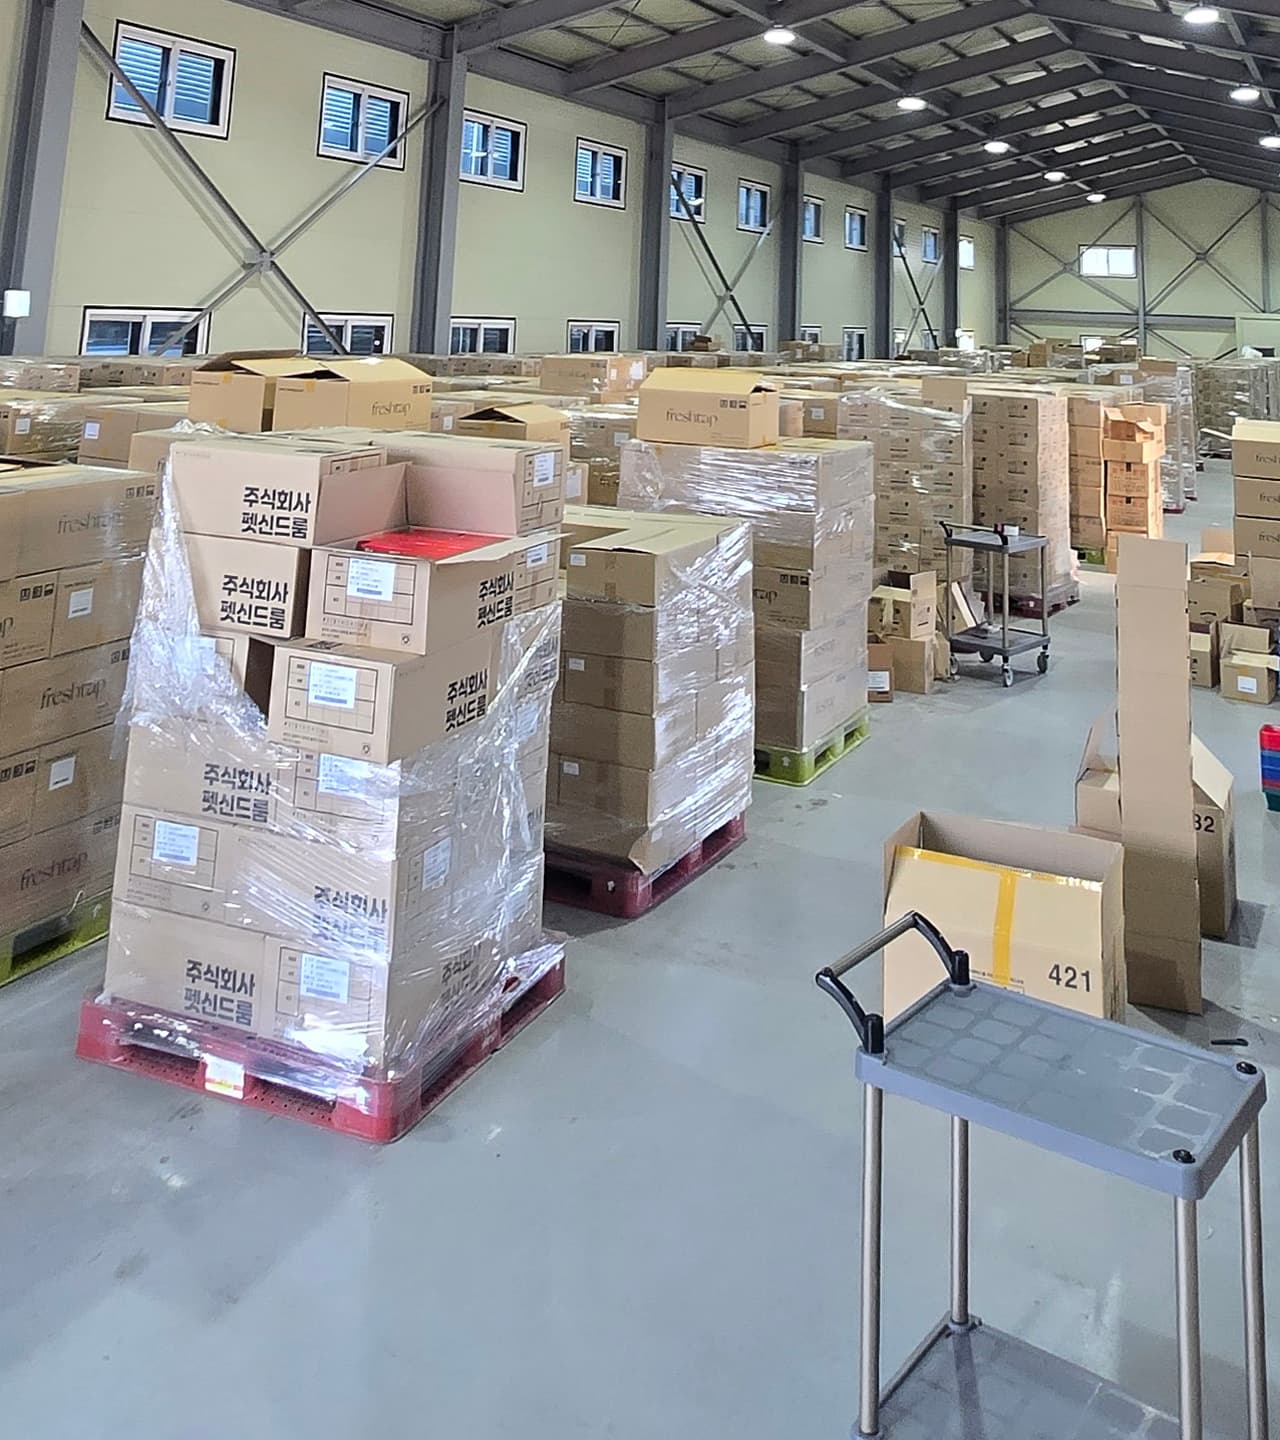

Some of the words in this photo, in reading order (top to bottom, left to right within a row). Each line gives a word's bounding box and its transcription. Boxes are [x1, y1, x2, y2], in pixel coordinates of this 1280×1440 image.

[371, 400, 411, 416] freshtap
[666, 409, 718, 427] freshtap
[243, 486, 311, 513] 주식회사
[241, 512, 308, 539] 펫신드룸
[222, 574, 289, 604] 주식회사
[479, 572, 514, 602] 주식회사
[220, 600, 286, 630] 펫신드룸
[477, 596, 513, 628] 펫신드룸
[41, 678, 107, 709] freshtap
[447, 669, 489, 704] 주식회사
[446, 694, 487, 732] 펫신드룸
[203, 763, 272, 796] 주식회사
[202, 790, 269, 823] 펫신드룸
[21, 852, 88, 891] freshtap
[186, 960, 255, 997] 주식회사
[1048, 964, 1090, 992] 421
[184, 987, 253, 1026] 펫신드룸
